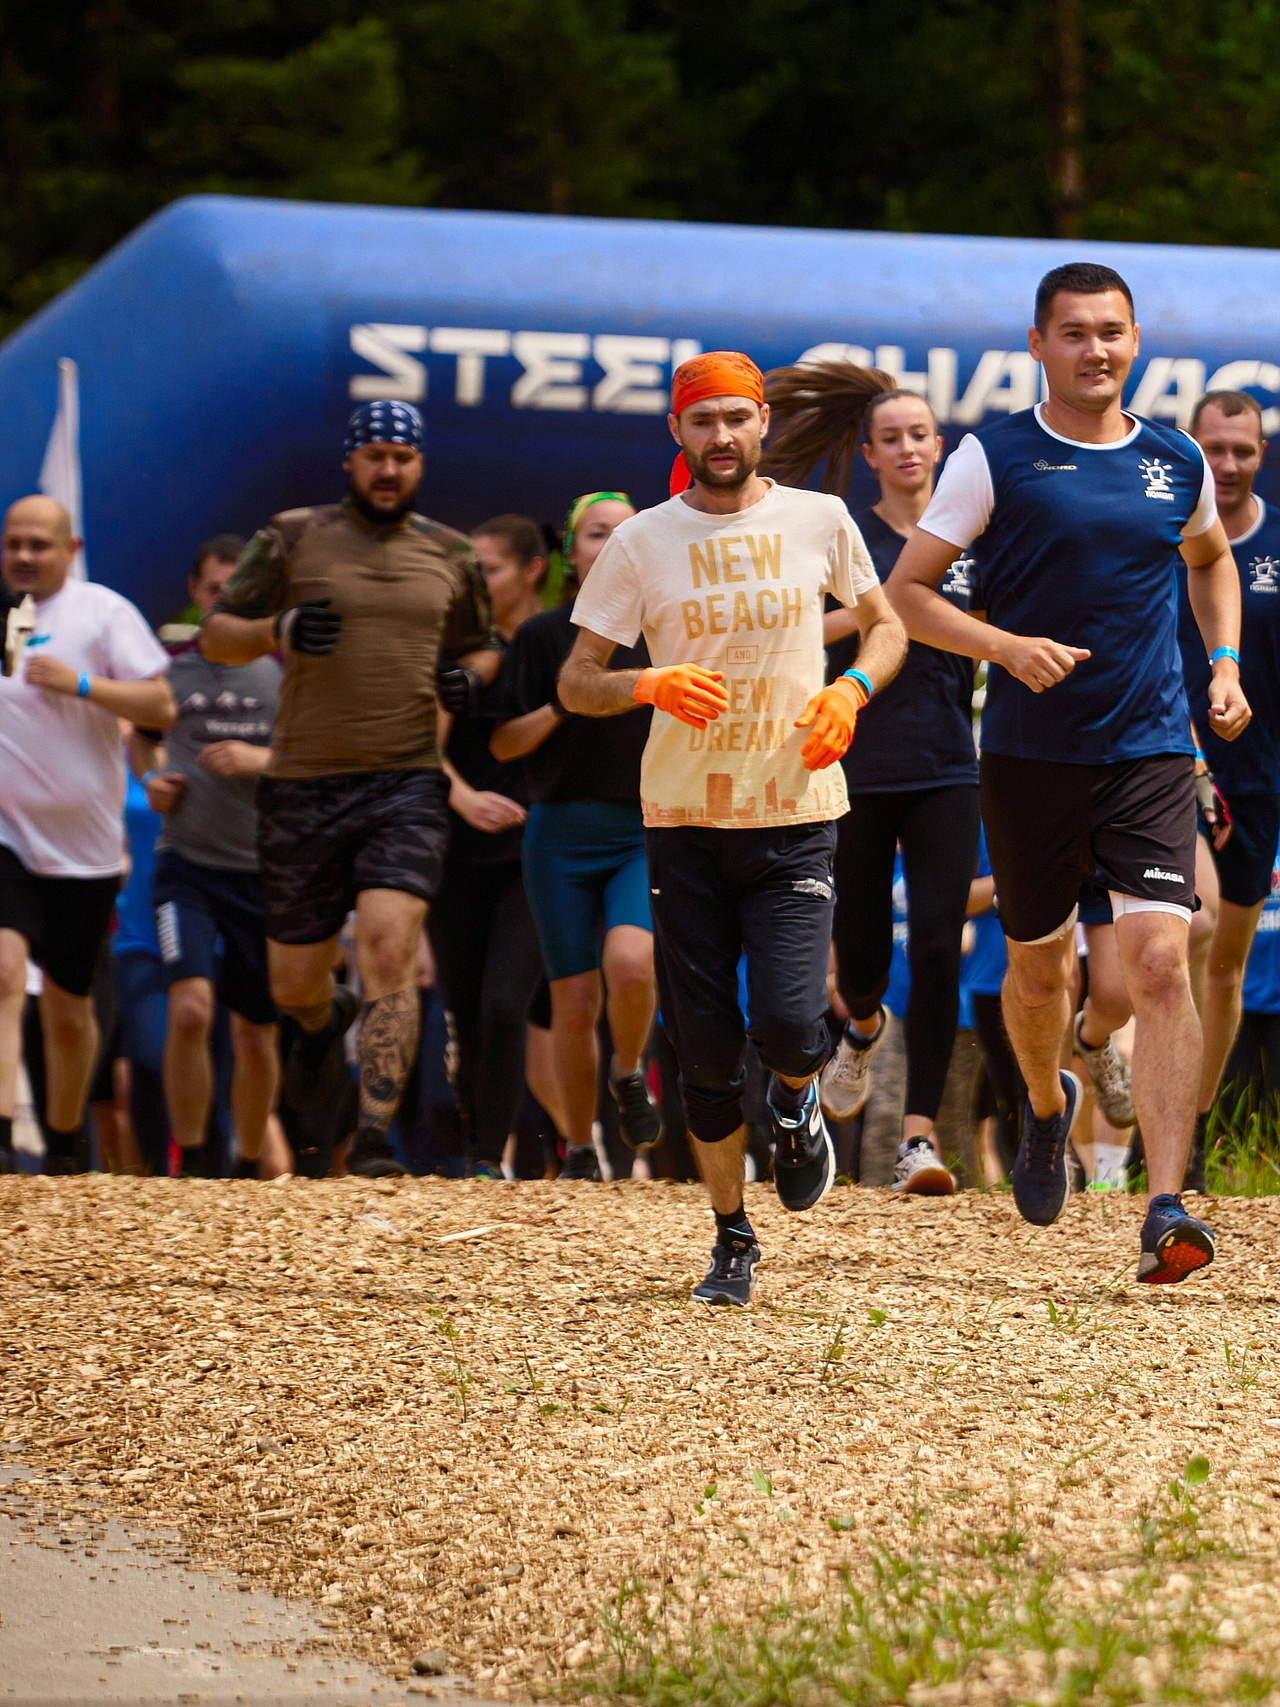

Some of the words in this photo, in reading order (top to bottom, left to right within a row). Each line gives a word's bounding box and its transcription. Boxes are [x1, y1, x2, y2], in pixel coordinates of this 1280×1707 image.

[349, 322, 700, 416] STEE
[688, 533, 782, 589] NEW
[680, 586, 802, 640] BEACH
[733, 649, 751, 660] AND
[688, 718, 786, 752] DREAM
